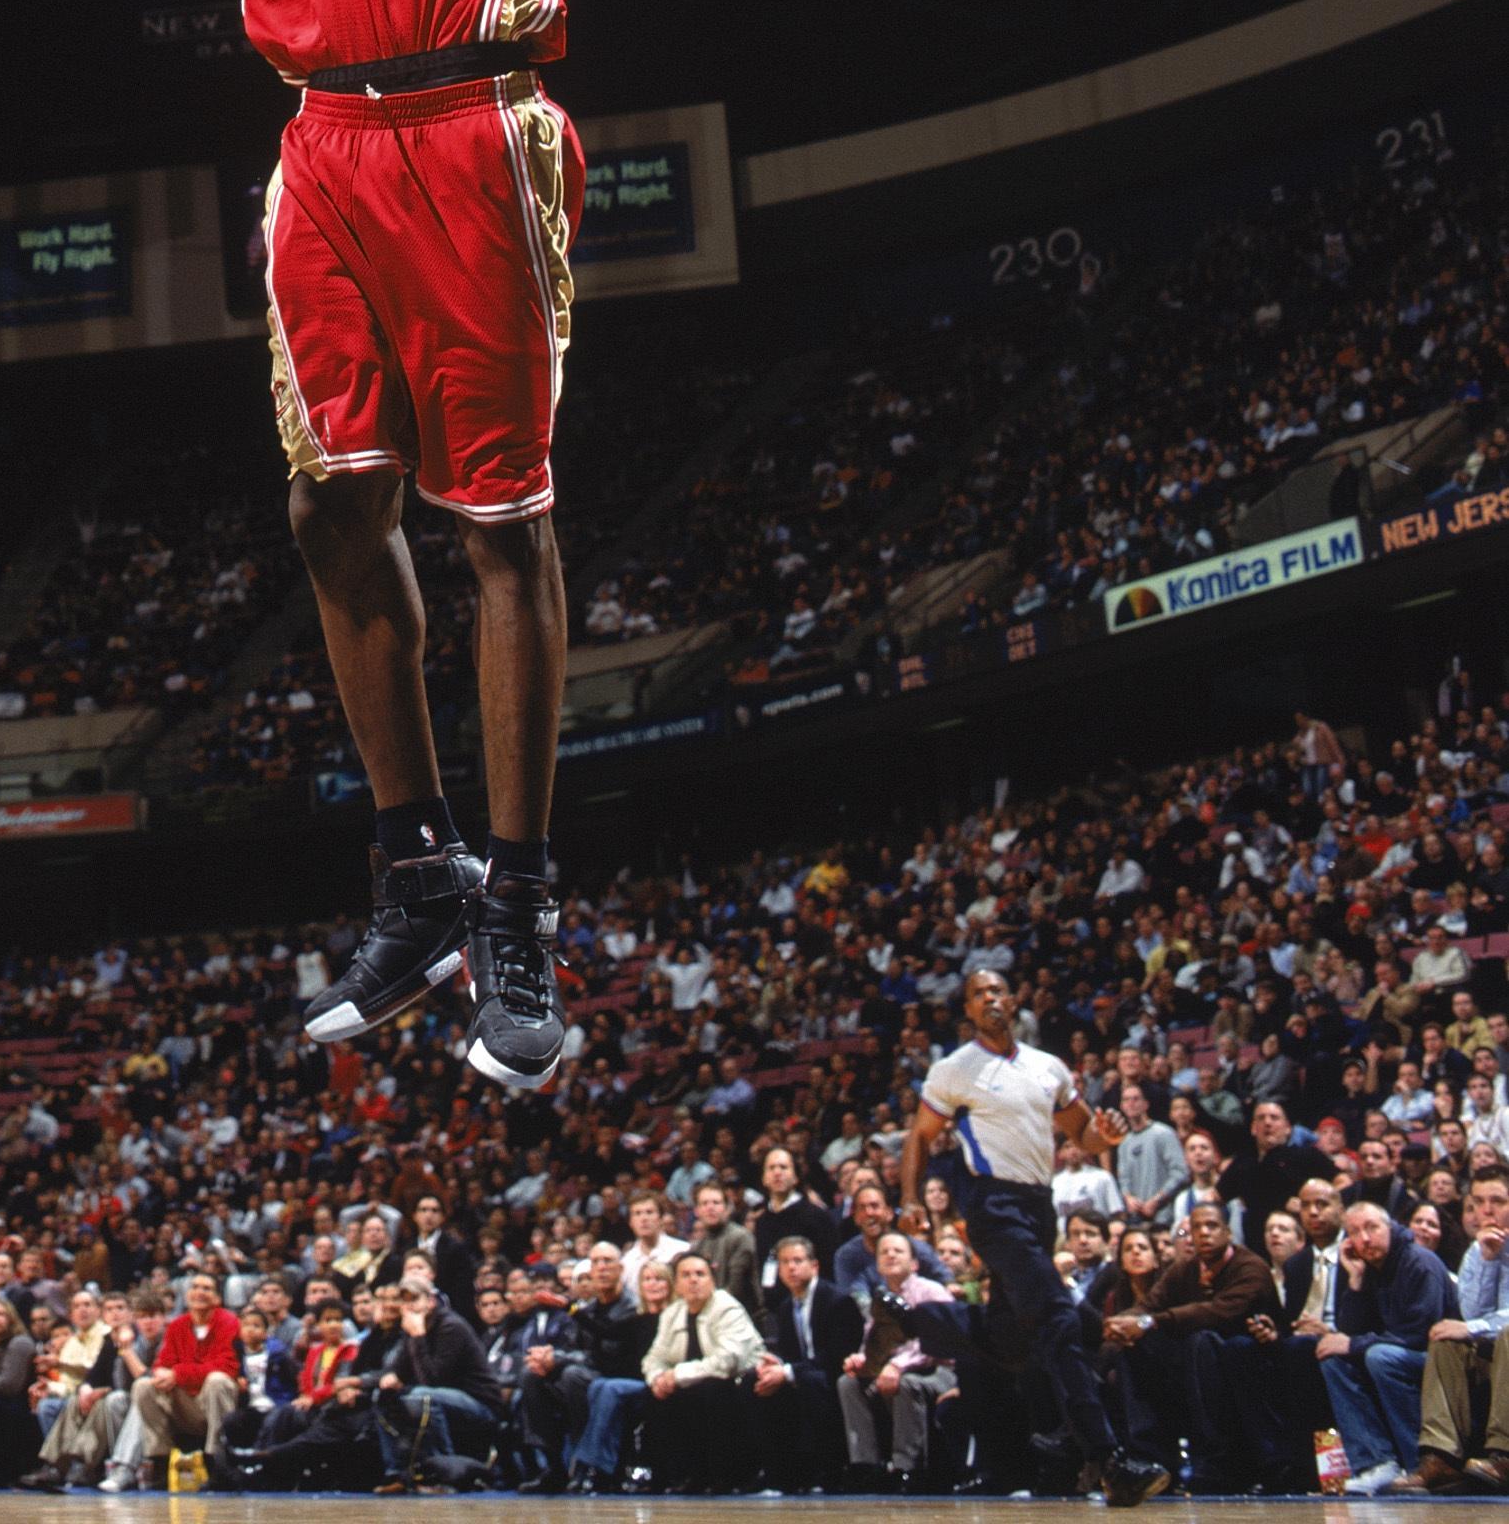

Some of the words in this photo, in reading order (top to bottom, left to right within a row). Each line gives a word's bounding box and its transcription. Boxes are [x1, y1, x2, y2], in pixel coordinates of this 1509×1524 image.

[584, 164, 616, 186] ork
[990, 228, 1083, 282] 230
[1381, 509, 1440, 553] NEW
[1166, 557, 1272, 613] Konica
[1280, 532, 1357, 577] FILM
